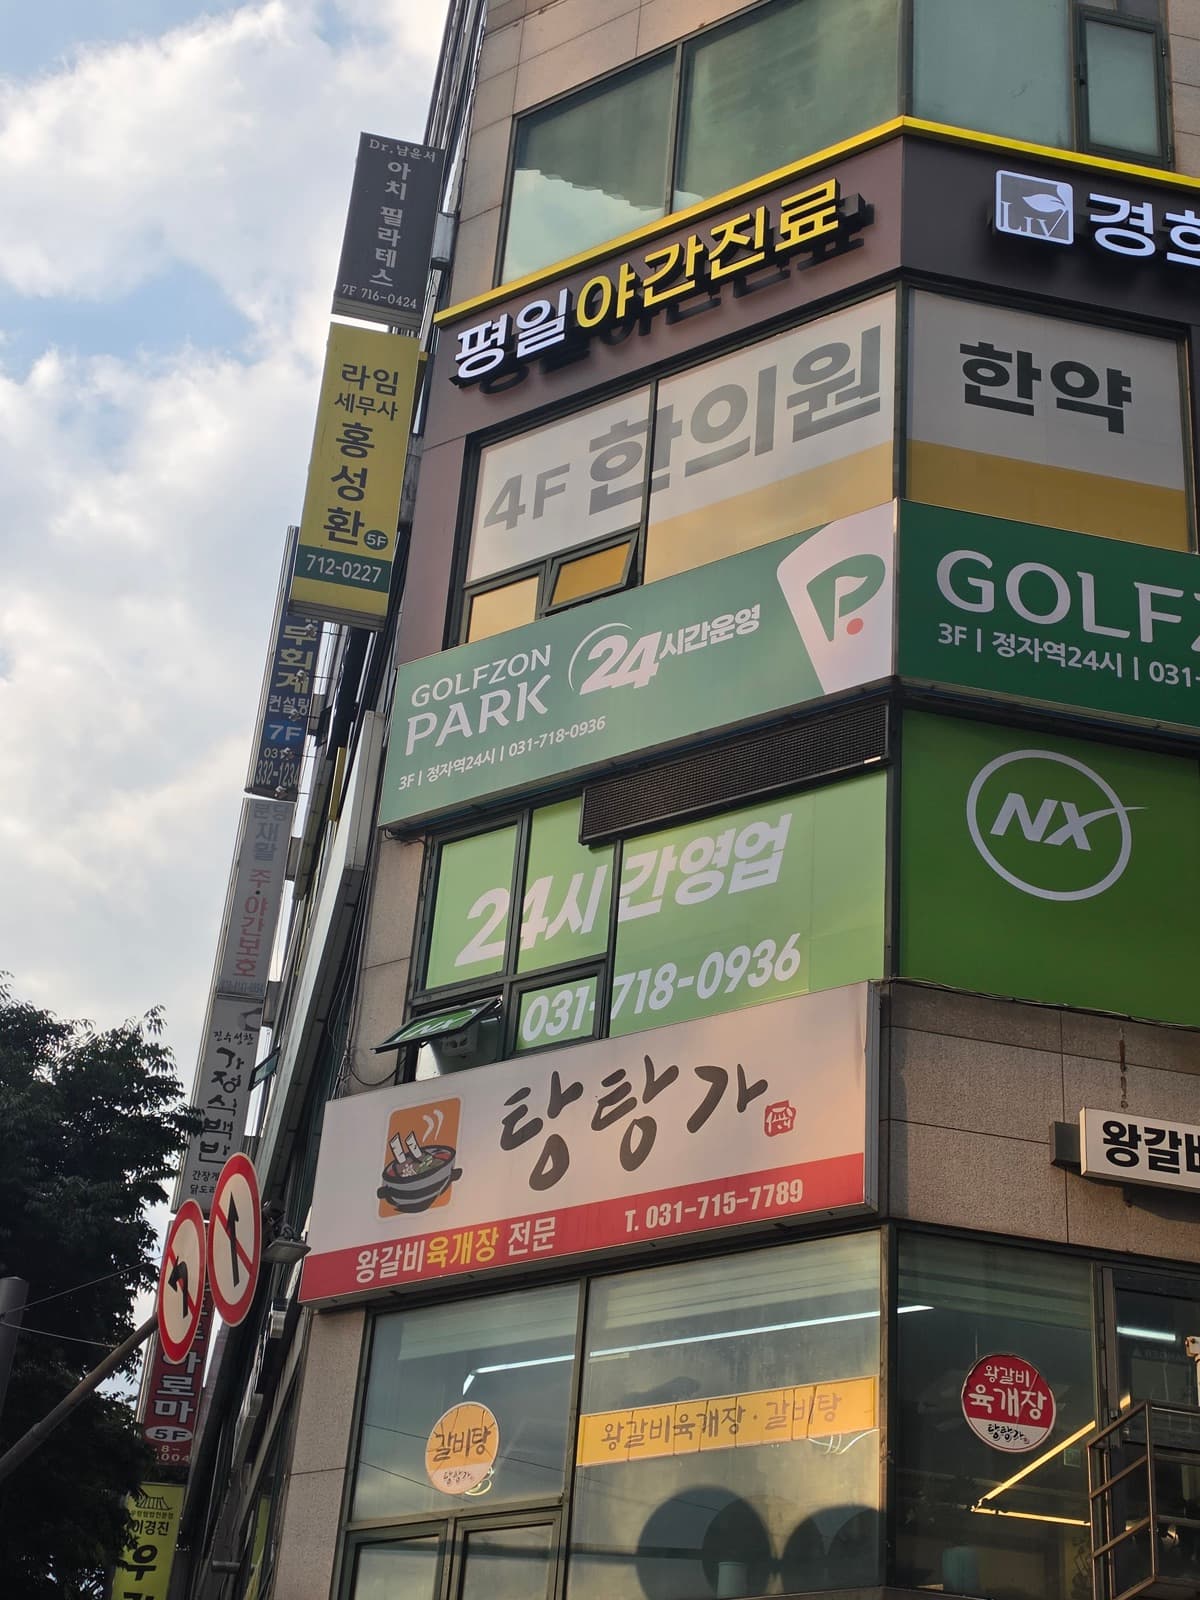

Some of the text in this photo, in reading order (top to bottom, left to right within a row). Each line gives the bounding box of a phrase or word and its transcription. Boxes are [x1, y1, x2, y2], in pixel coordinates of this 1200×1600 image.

[369, 162, 411, 287] 아치 필라테스
[1000, 200, 1067, 238] LIV
[342, 283, 417, 309] 7F 716-0424
[334, 392, 399, 421] 세무사
[341, 363, 399, 397] 라임
[960, 341, 1132, 434] 한약
[483, 325, 881, 530] 4F 한의원
[323, 422, 375, 546] 홍성환
[366, 532, 387, 547] 5F
[306, 554, 382, 584] 712-0227
[937, 549, 1200, 653] GOLF
[411, 643, 553, 708] GOLFZON
[579, 603, 761, 696] 24시간운영
[937, 623, 967, 646] 3F
[993, 631, 1123, 678] 정자역24시
[269, 724, 302, 741] 7F
[404, 673, 552, 756] PARK
[398, 716, 606, 791] 3F 정자역24시 031-718-0936
[990, 792, 1095, 851] NX
[455, 813, 792, 967] 24시간영업
[522, 932, 801, 1041] 031-718-0936
[499, 1054, 769, 1191] 탕탕가
[624, 1179, 804, 1233] T. 031-715-7789
[355, 1216, 556, 1285] 왕갈비육개장 전문
[968, 1384, 1048, 1419] 육개장
[985, 1364, 1030, 1387] 왕갈비
[154, 1429, 188, 1442] 5F
[765, 1392, 843, 1432] 갈비탕
[433, 1425, 492, 1463] 갈비탕
